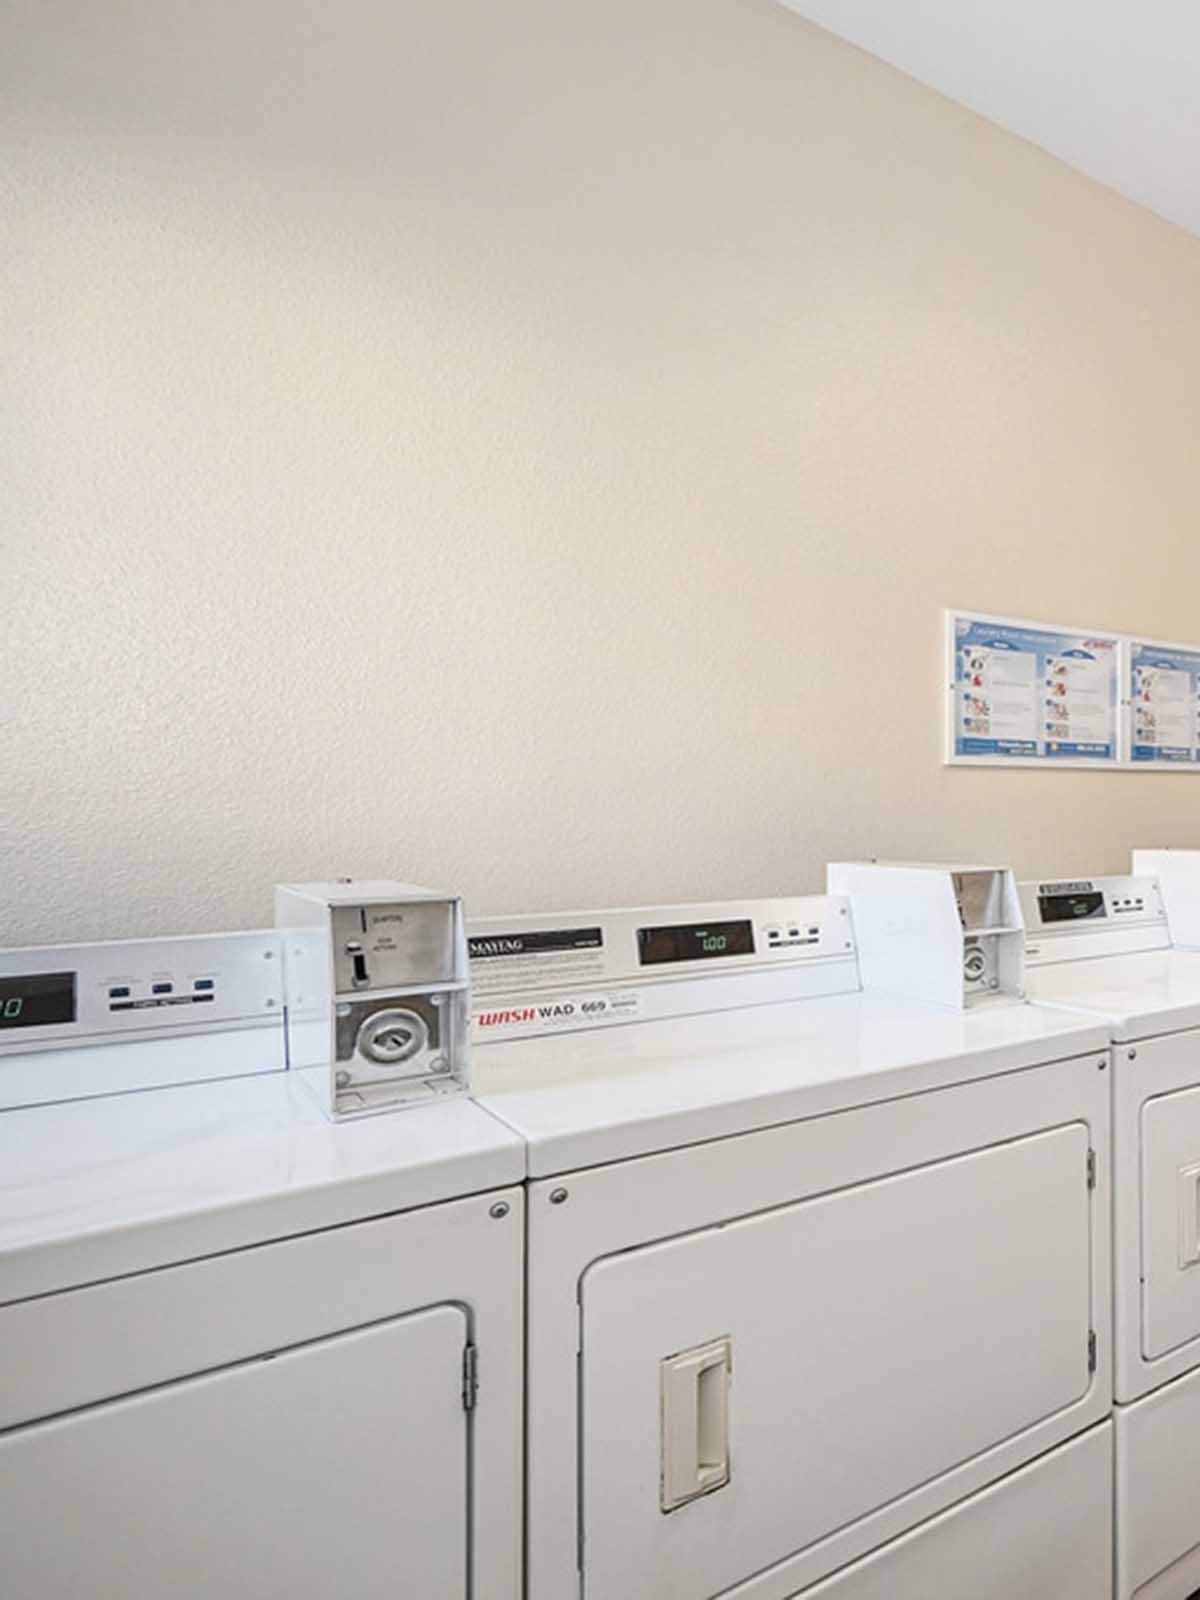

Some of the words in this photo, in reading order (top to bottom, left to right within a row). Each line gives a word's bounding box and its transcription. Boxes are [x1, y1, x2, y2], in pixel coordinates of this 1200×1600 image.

[469, 939, 524, 956] MAYTAG
[538, 1003, 576, 1019] WAD
[580, 1000, 607, 1014] 669
